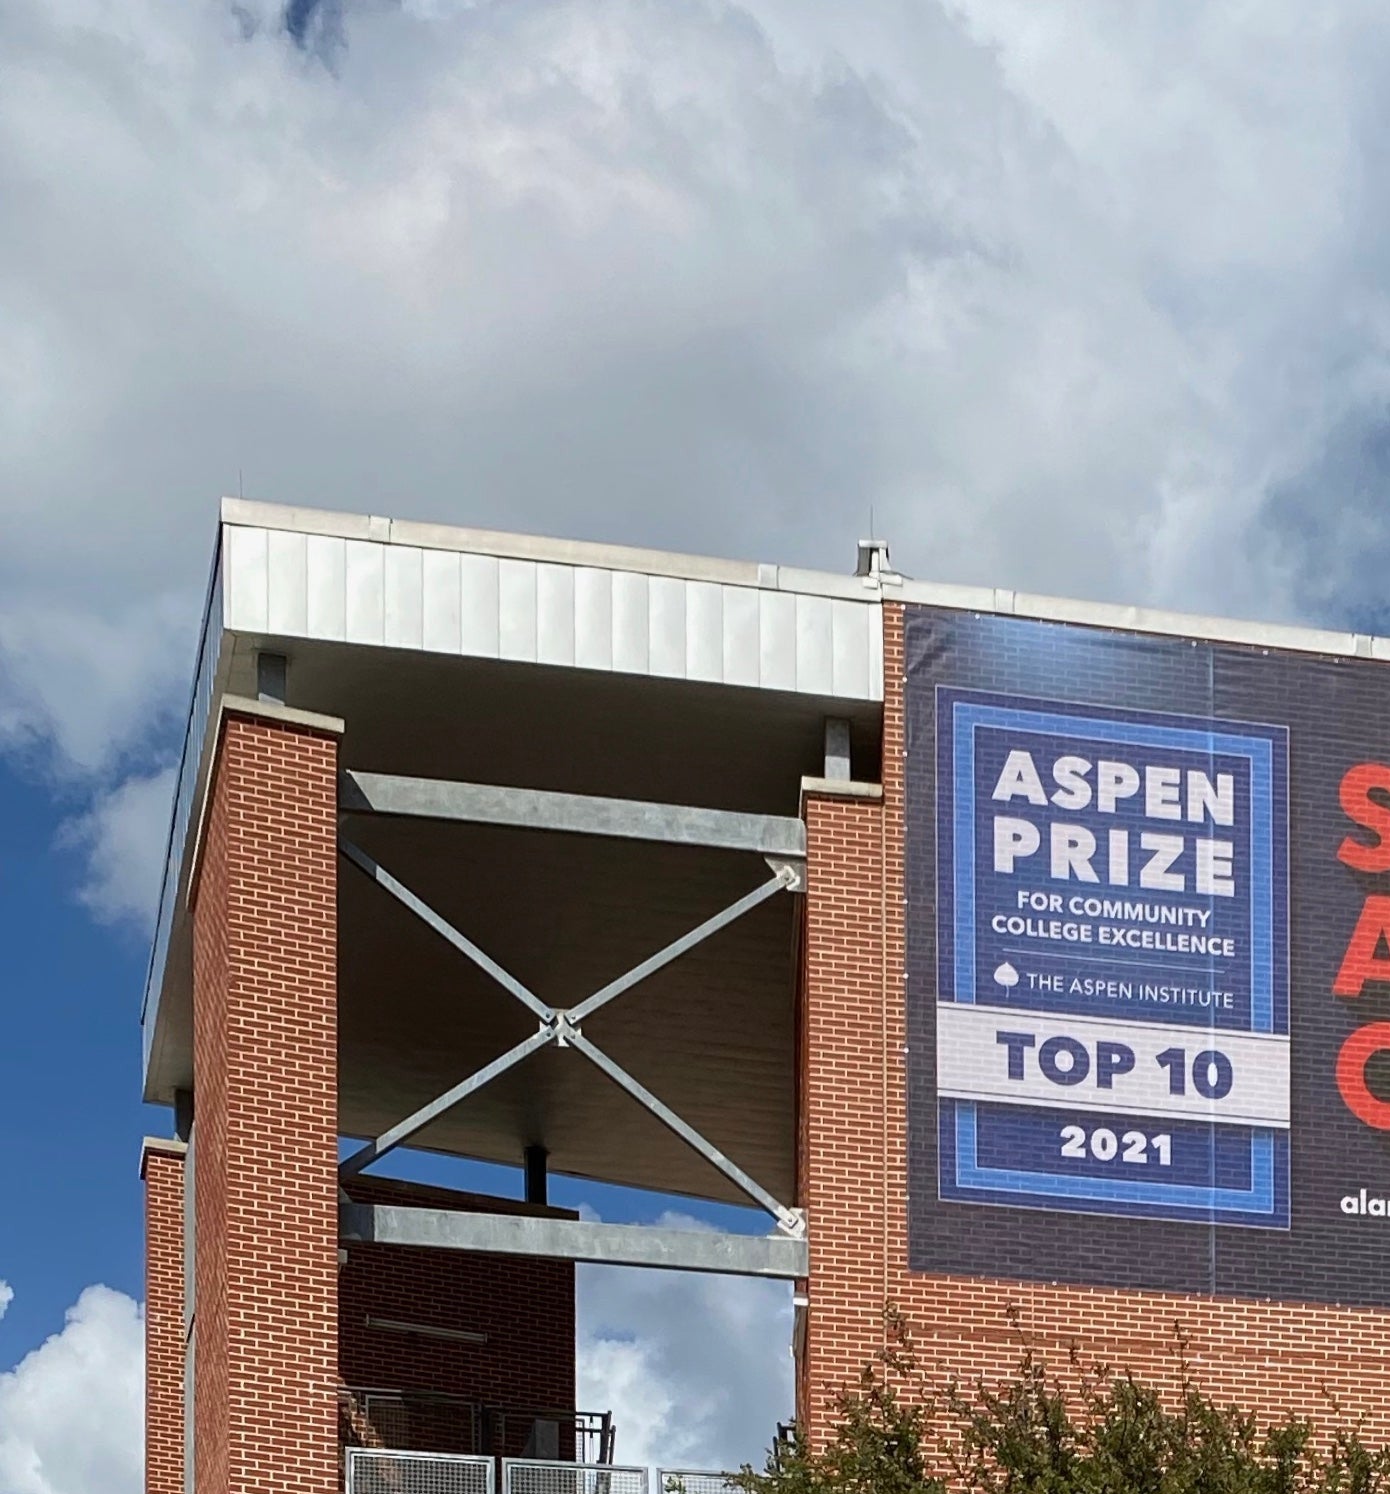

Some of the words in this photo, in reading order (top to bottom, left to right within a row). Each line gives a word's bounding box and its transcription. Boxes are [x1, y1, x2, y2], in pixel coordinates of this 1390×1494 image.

[992, 750, 1235, 827] ASPEN
[993, 815, 1236, 898] PRIZE
[1017, 890, 1064, 914] FOR
[1069, 895, 1211, 929] COMMUNITY
[991, 914, 1094, 944] COLLEGE
[1099, 925, 1236, 958] EXCELLENCE
[1026, 972, 1065, 993] THE
[1069, 977, 1134, 1000] ASPEN
[1138, 984, 1235, 1009] INSTITUTE
[996, 1030, 1136, 1090] TOP
[1156, 1046, 1234, 1100] 10
[1060, 1124, 1173, 1167] 2021
